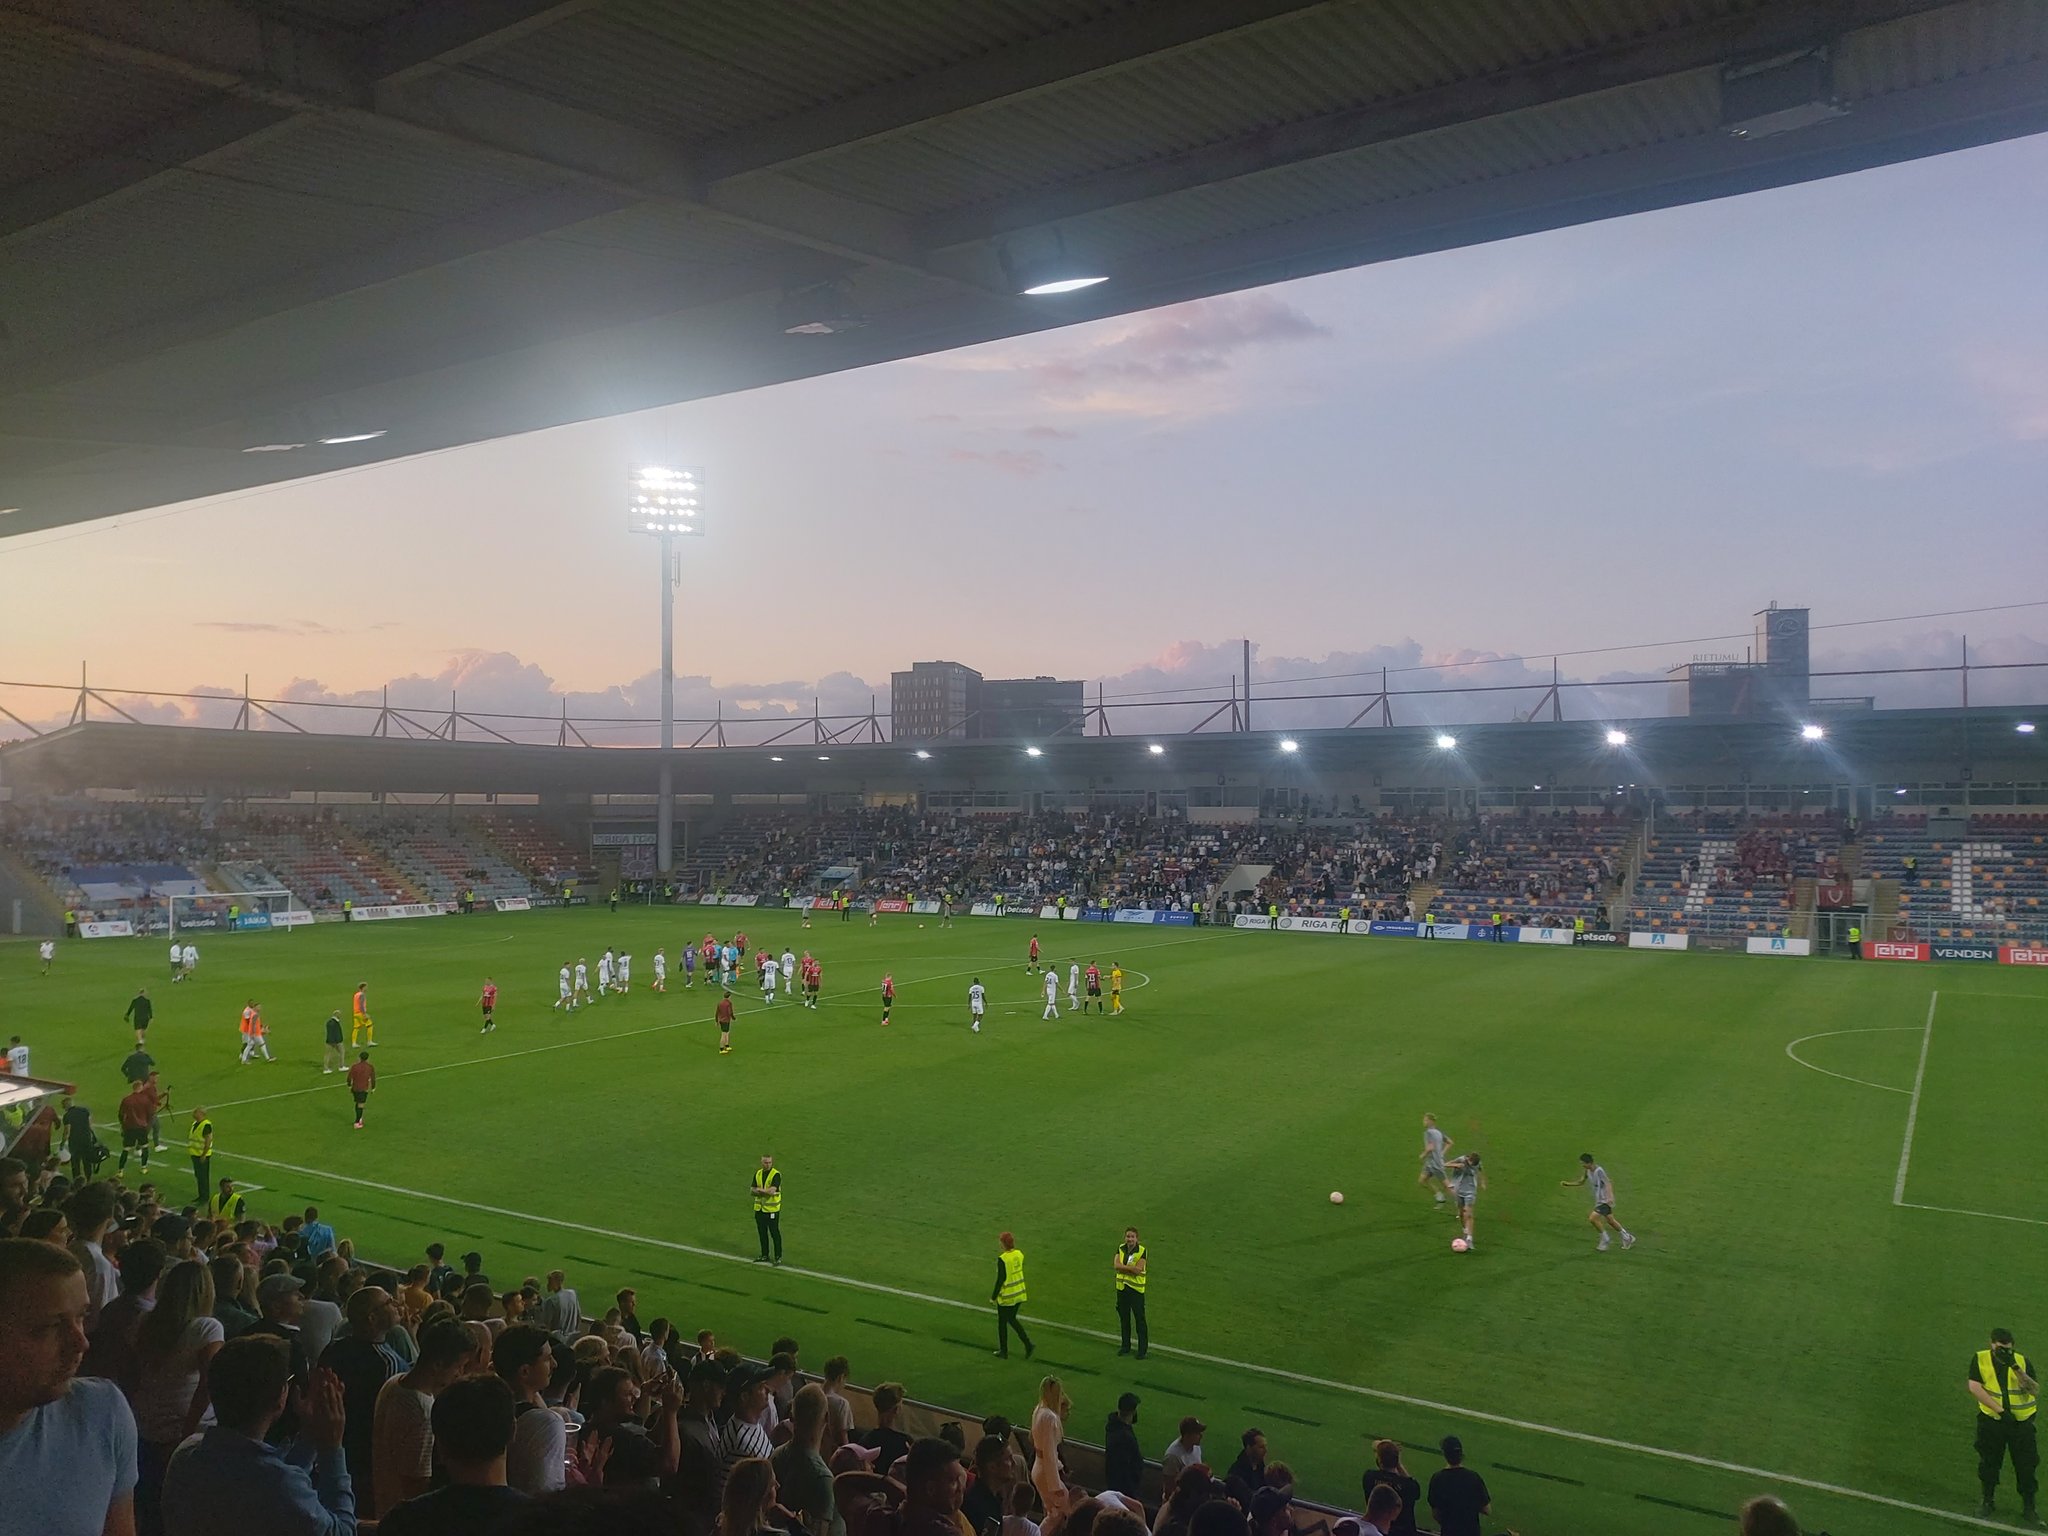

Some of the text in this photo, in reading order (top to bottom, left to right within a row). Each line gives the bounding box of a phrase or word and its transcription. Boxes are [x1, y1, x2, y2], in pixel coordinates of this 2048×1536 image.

[1007, 906, 1034, 914] betsafe
[1301, 920, 1328, 929] RIGA
[1935, 949, 1993, 959] VENDEN
